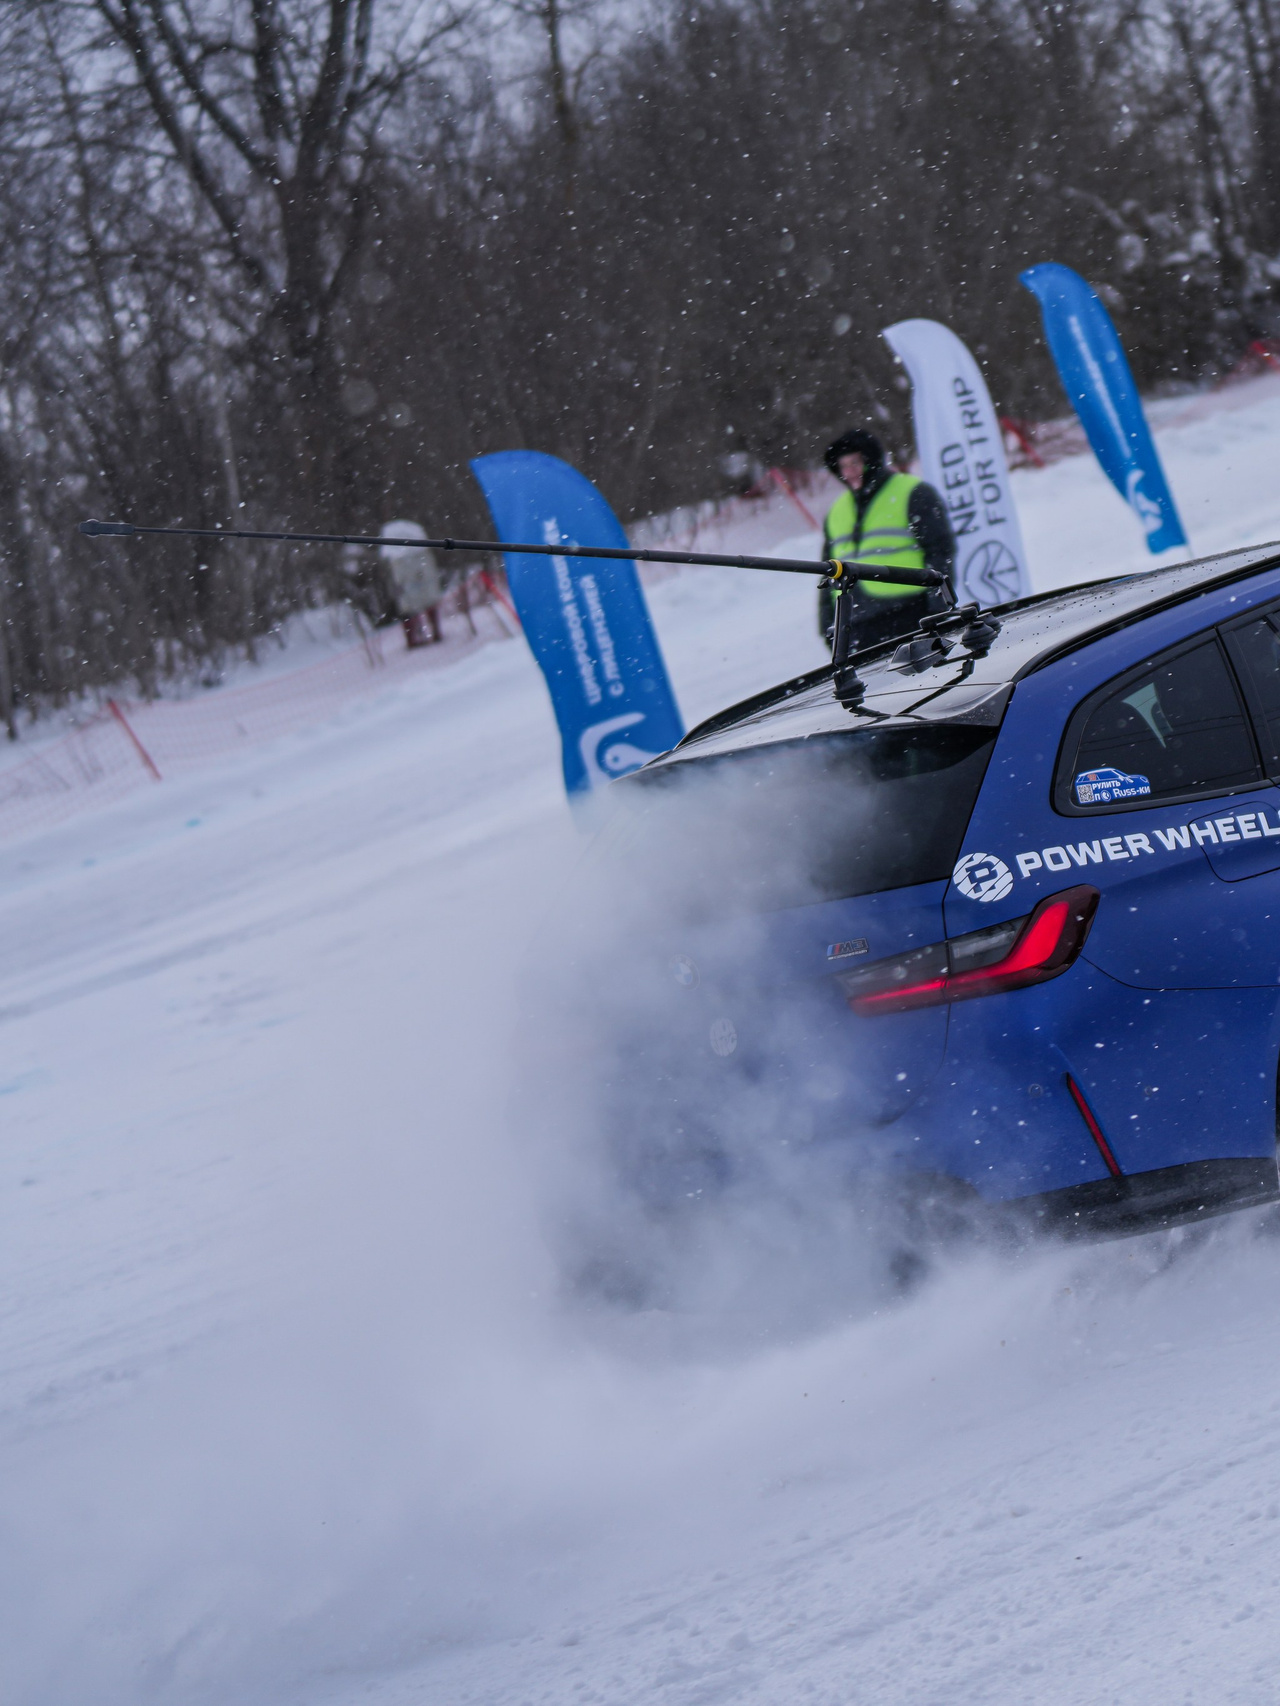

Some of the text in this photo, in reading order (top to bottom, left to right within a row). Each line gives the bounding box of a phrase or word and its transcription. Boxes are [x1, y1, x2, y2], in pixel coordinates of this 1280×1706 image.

[954, 377, 1007, 527] FOR TRIP
[940, 443, 980, 537] NEED
[1091, 780, 1121, 790] РУЛИТЬ
[1015, 832, 1154, 877] POWER
